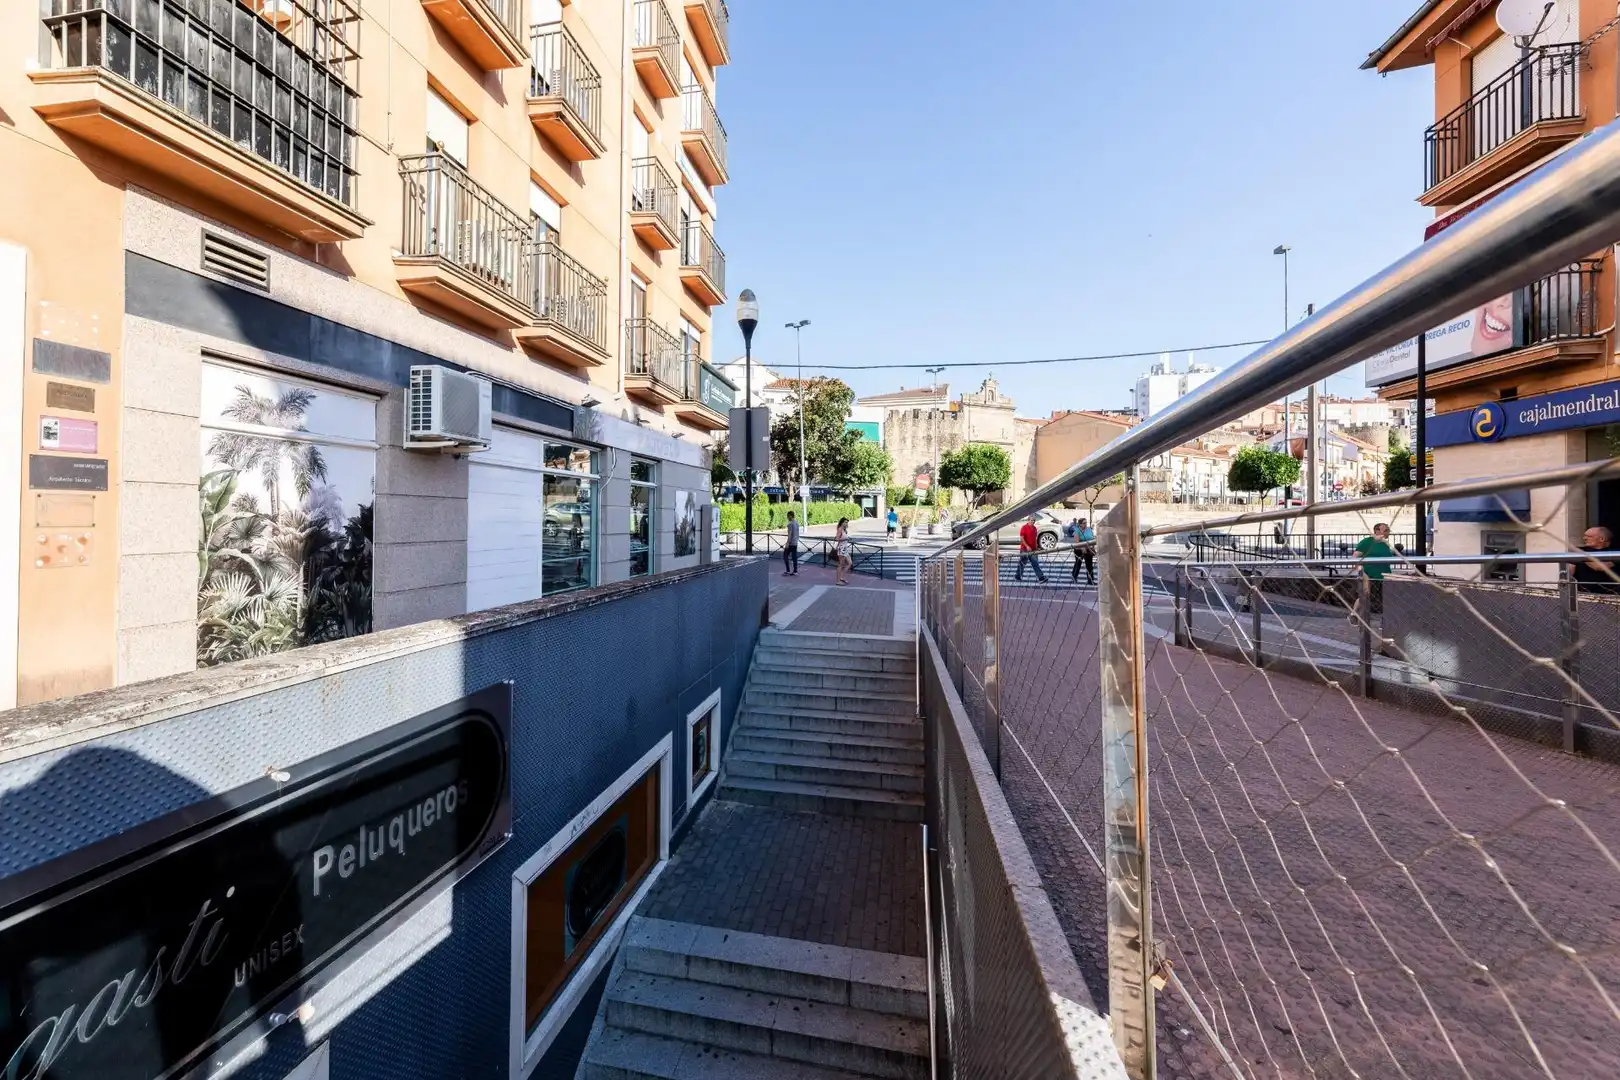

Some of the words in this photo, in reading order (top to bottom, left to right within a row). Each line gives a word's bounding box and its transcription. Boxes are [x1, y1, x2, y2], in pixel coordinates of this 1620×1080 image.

[1415, 328, 1446, 344] BRREGA
[1448, 319, 1470, 333] RECIO
[1519, 389, 1620, 427] cajalmendral
[313, 779, 469, 897] Peluqueros
[234, 923, 305, 988] UNISEX
